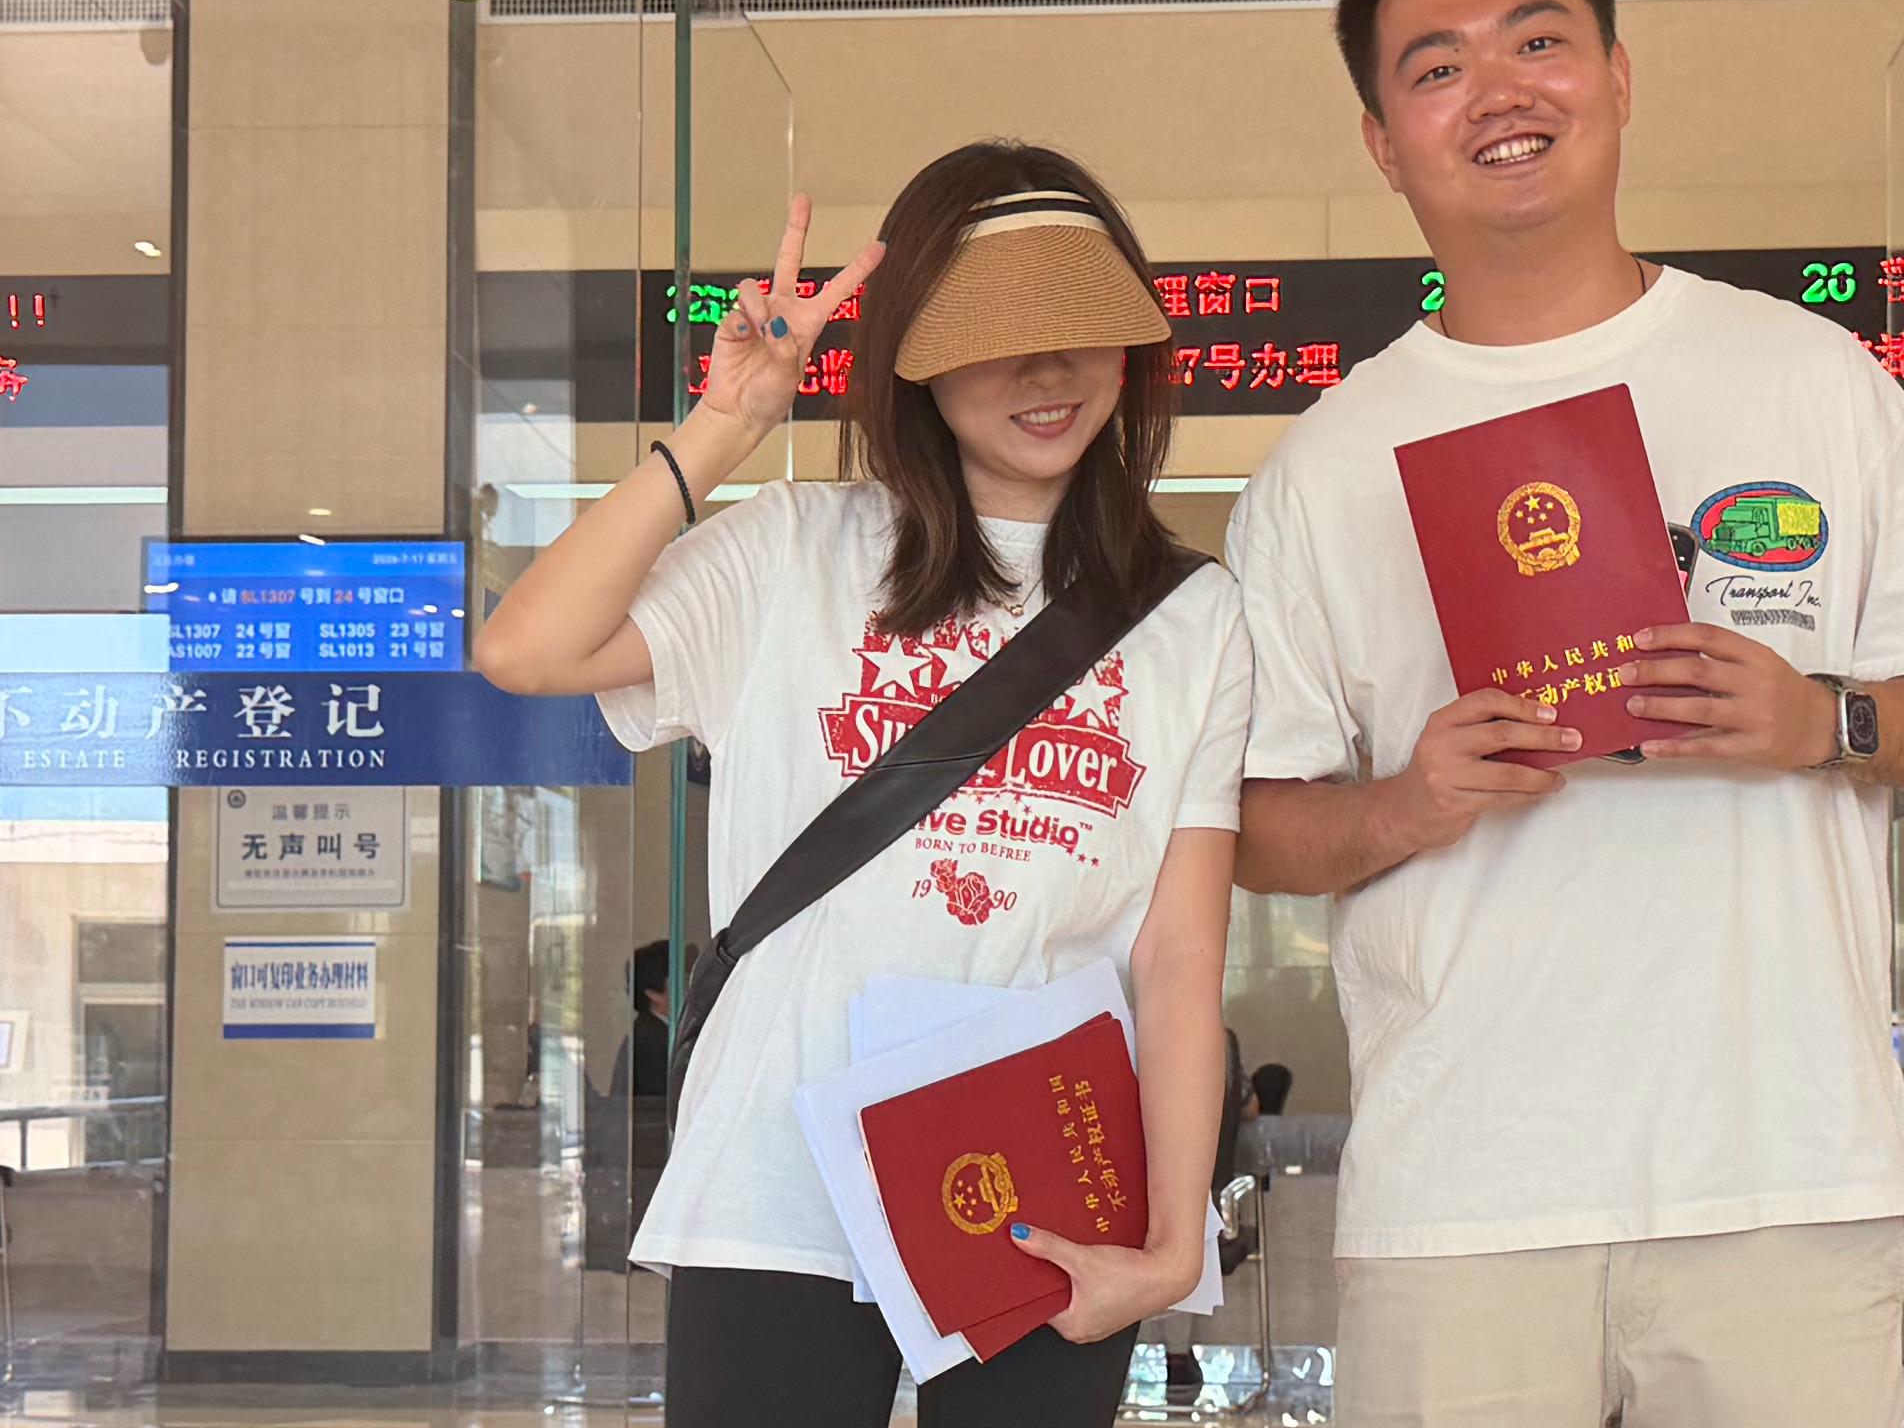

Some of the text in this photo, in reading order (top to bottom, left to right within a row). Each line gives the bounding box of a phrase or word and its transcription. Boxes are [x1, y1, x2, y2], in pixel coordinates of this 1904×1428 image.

[235, 624, 256, 639] 24
[235, 645, 256, 659] 22
[23, 748, 128, 769] ESTATE
[175, 748, 389, 769] REGISTRATION
[241, 832, 381, 861] 无声叫号
[914, 837, 954, 853] BORN
[958, 841, 977, 854] TO
[911, 877, 932, 900] 19
[1048, 1074, 1111, 1234] 中华人民共和国
[1075, 1079, 1130, 1212] 不动产权证书
